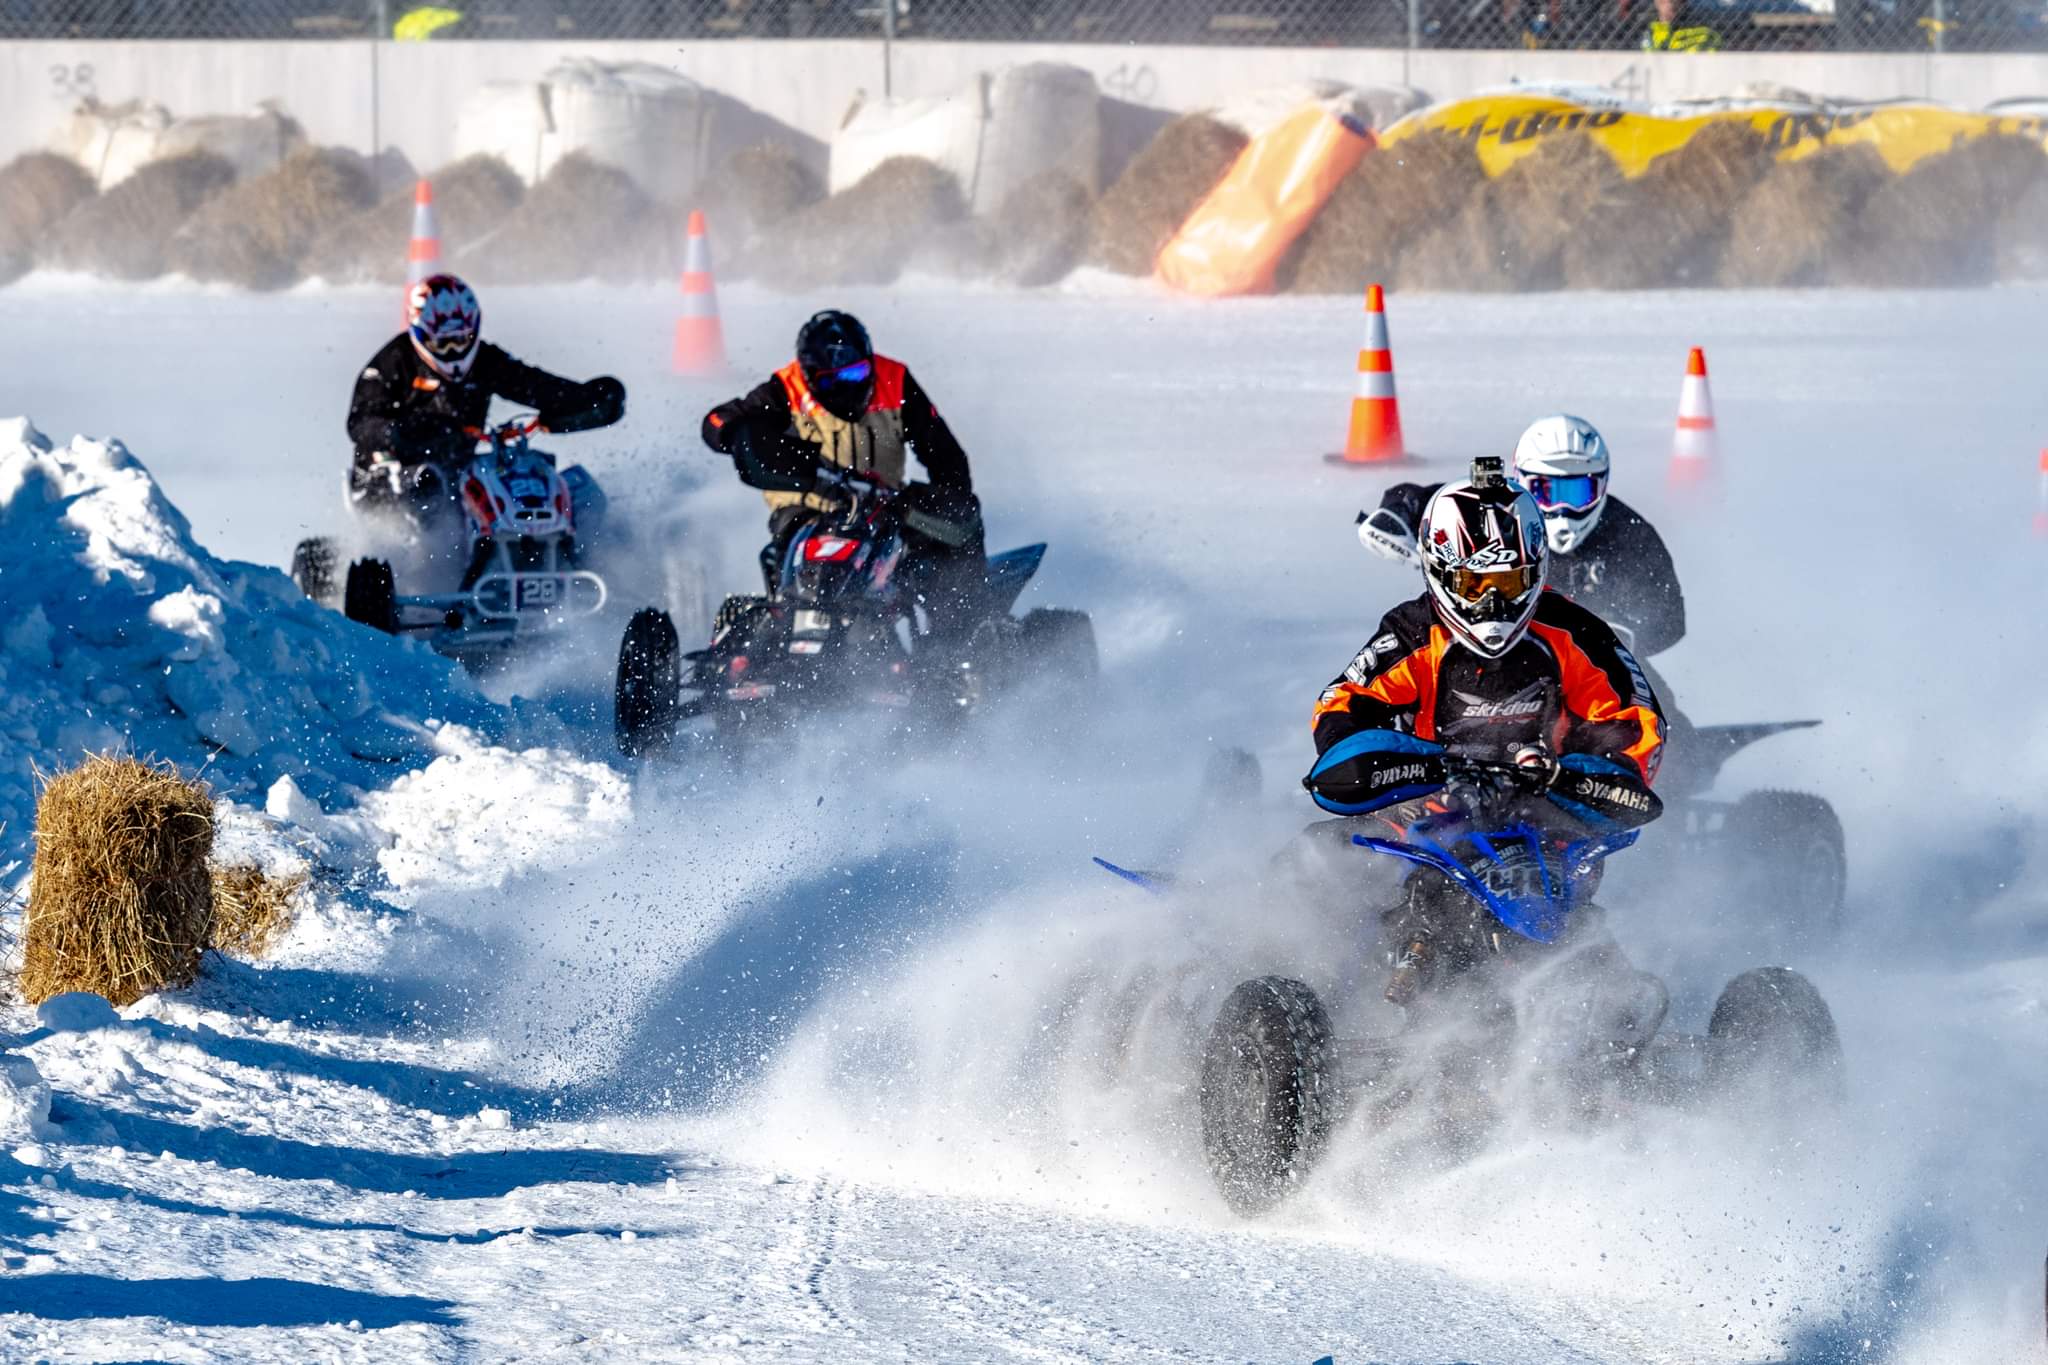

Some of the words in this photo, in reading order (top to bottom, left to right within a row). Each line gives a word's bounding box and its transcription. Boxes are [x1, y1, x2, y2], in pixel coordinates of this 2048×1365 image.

[1103, 62, 1158, 101] 40
[522, 579, 556, 604] 28
[1593, 782, 1650, 812] YAMAHA
